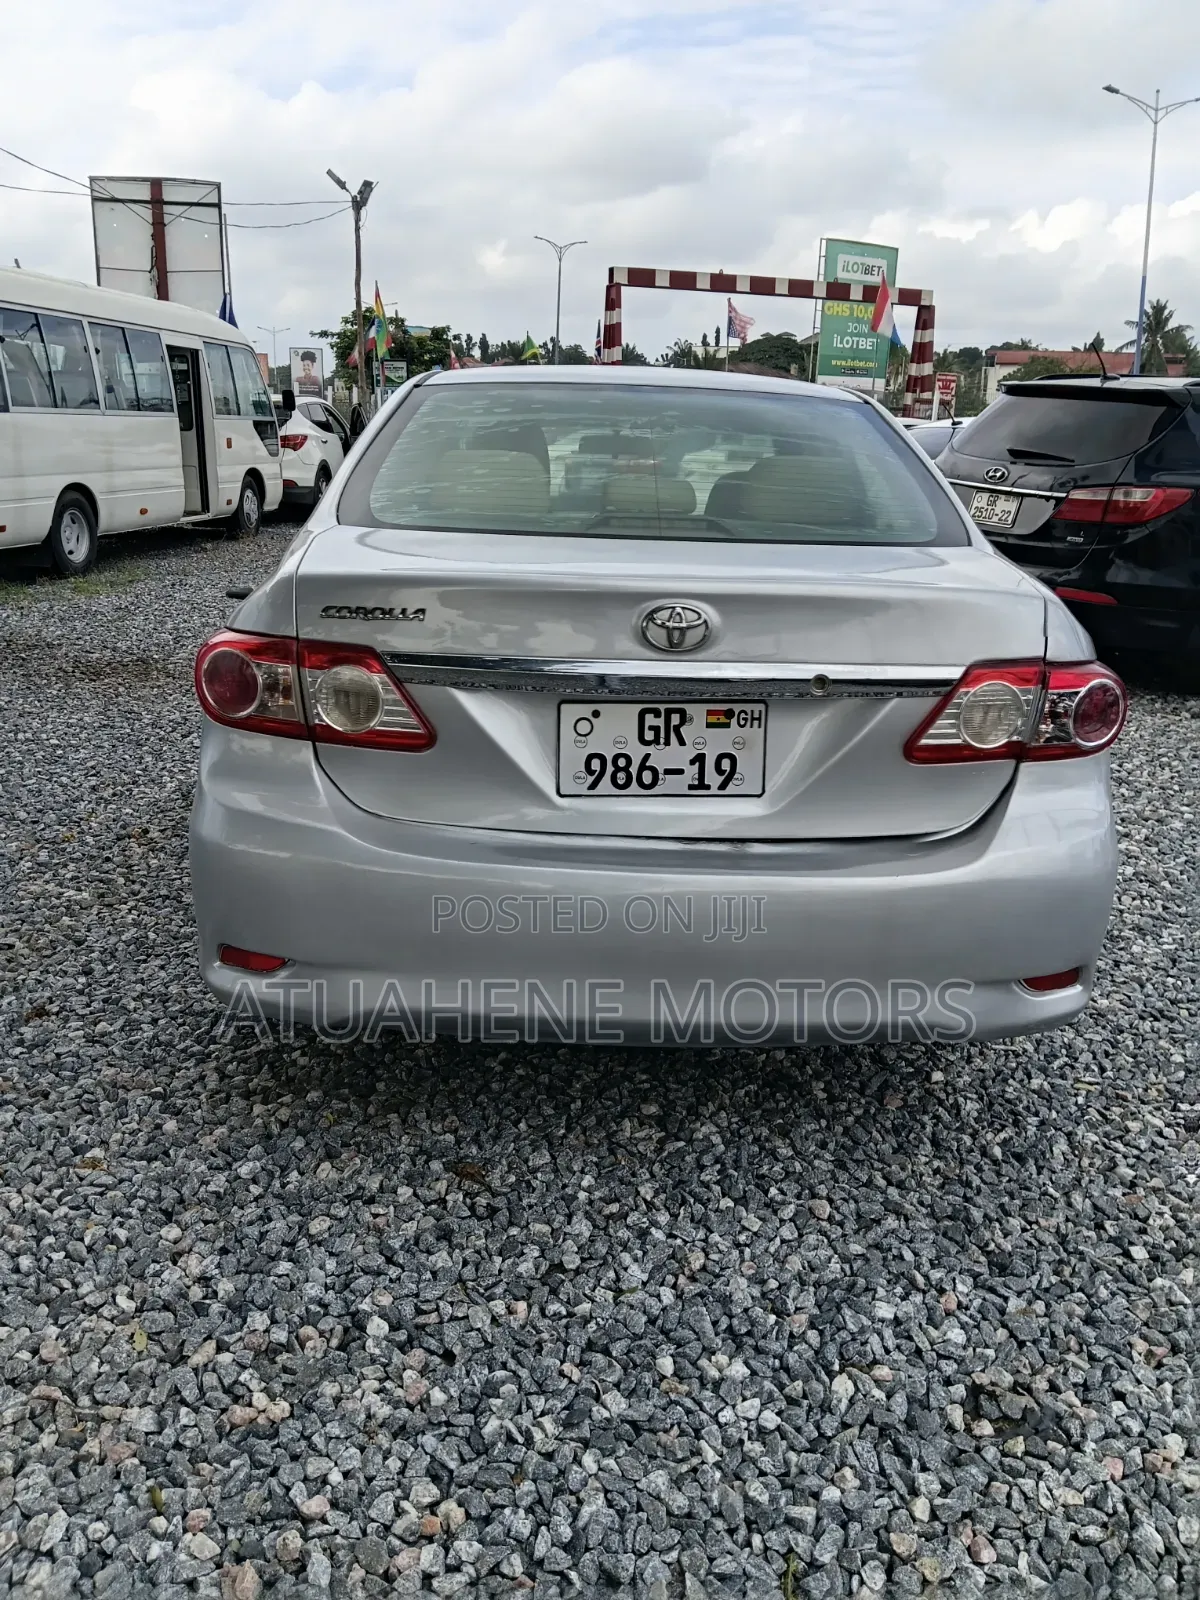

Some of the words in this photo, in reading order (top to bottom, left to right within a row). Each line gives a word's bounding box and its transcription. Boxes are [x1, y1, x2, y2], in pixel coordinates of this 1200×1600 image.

[842, 260, 882, 277] iLOTBET
[824, 302, 850, 316] GHS
[847, 322, 869, 334] JOIN
[833, 334, 878, 350] iLOTBET
[987, 494, 999, 507] GR
[320, 605, 426, 621] COROLLA
[637, 707, 687, 746] GR
[736, 709, 762, 729] GH
[584, 752, 738, 790] 986-19
